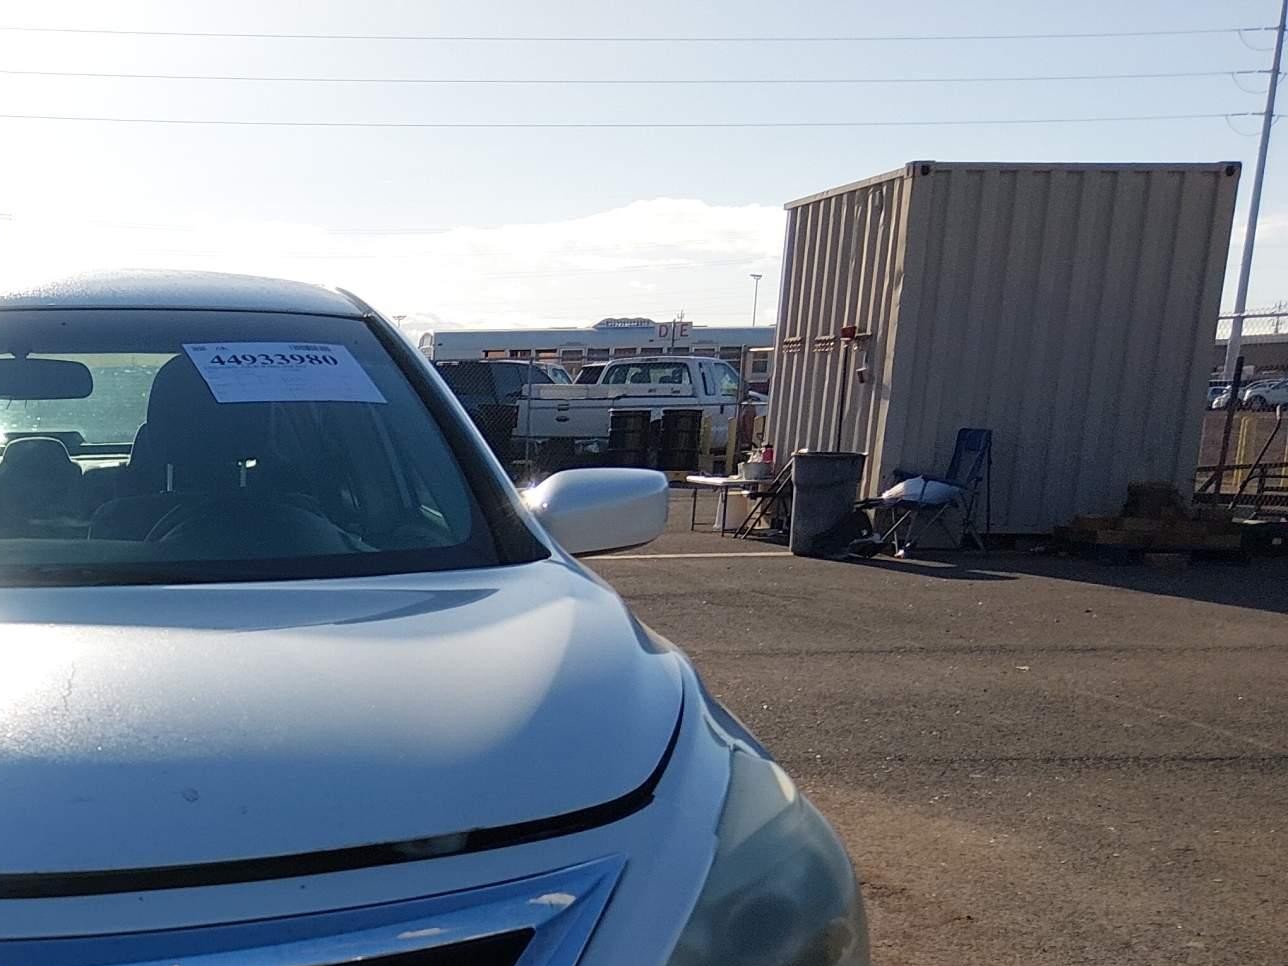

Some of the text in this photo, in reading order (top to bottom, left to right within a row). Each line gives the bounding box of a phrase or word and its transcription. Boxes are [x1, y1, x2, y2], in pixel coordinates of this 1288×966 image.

[658, 323, 689, 338] D E
[210, 353, 339, 366] 44933980
